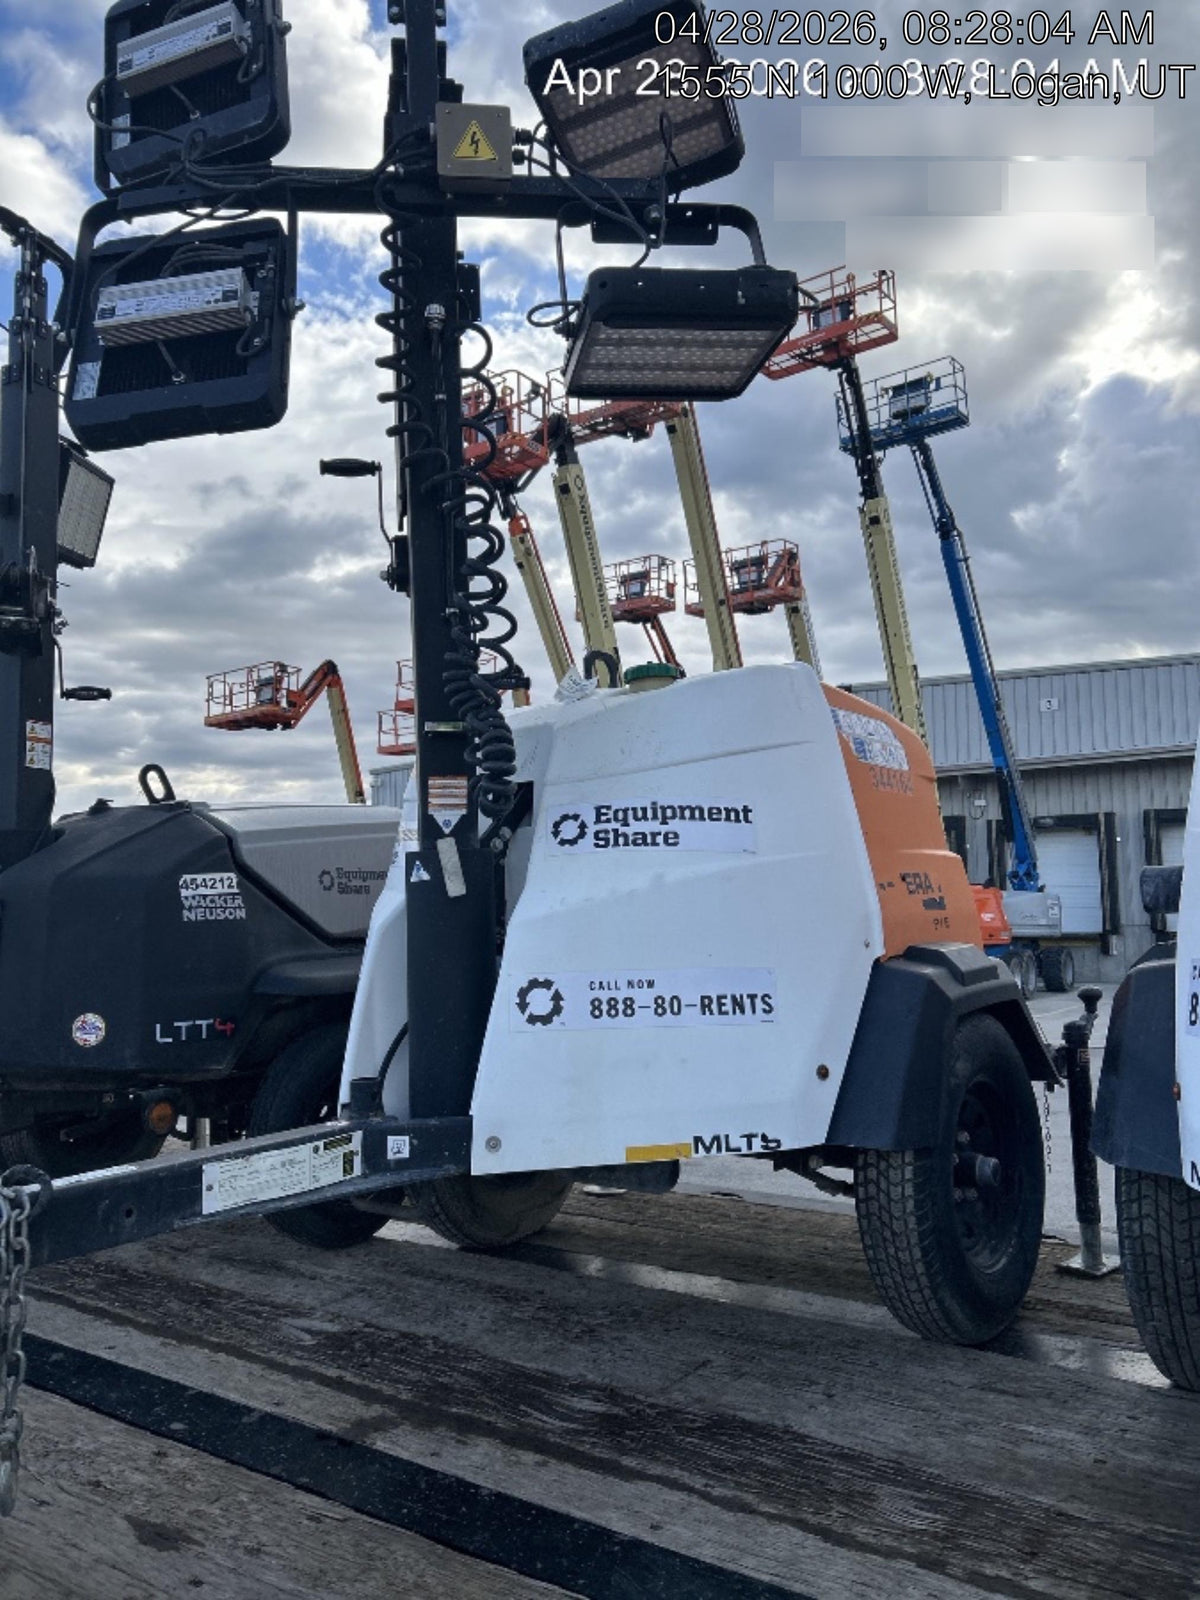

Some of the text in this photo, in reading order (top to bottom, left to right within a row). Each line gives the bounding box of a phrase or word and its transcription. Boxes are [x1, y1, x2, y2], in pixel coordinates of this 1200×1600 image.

[593, 801, 753, 827] Equipment
[593, 828, 680, 849] Share
[335, 866, 389, 882] Equipme
[180, 876, 236, 892] 454212
[338, 881, 371, 895] Share
[181, 895, 245, 909] WACKER
[182, 907, 246, 922] NEUSON
[589, 978, 656, 992] CALL NOW
[589, 993, 775, 1020] 888-80-RENTS
[155, 1018, 236, 1044] LTT4
